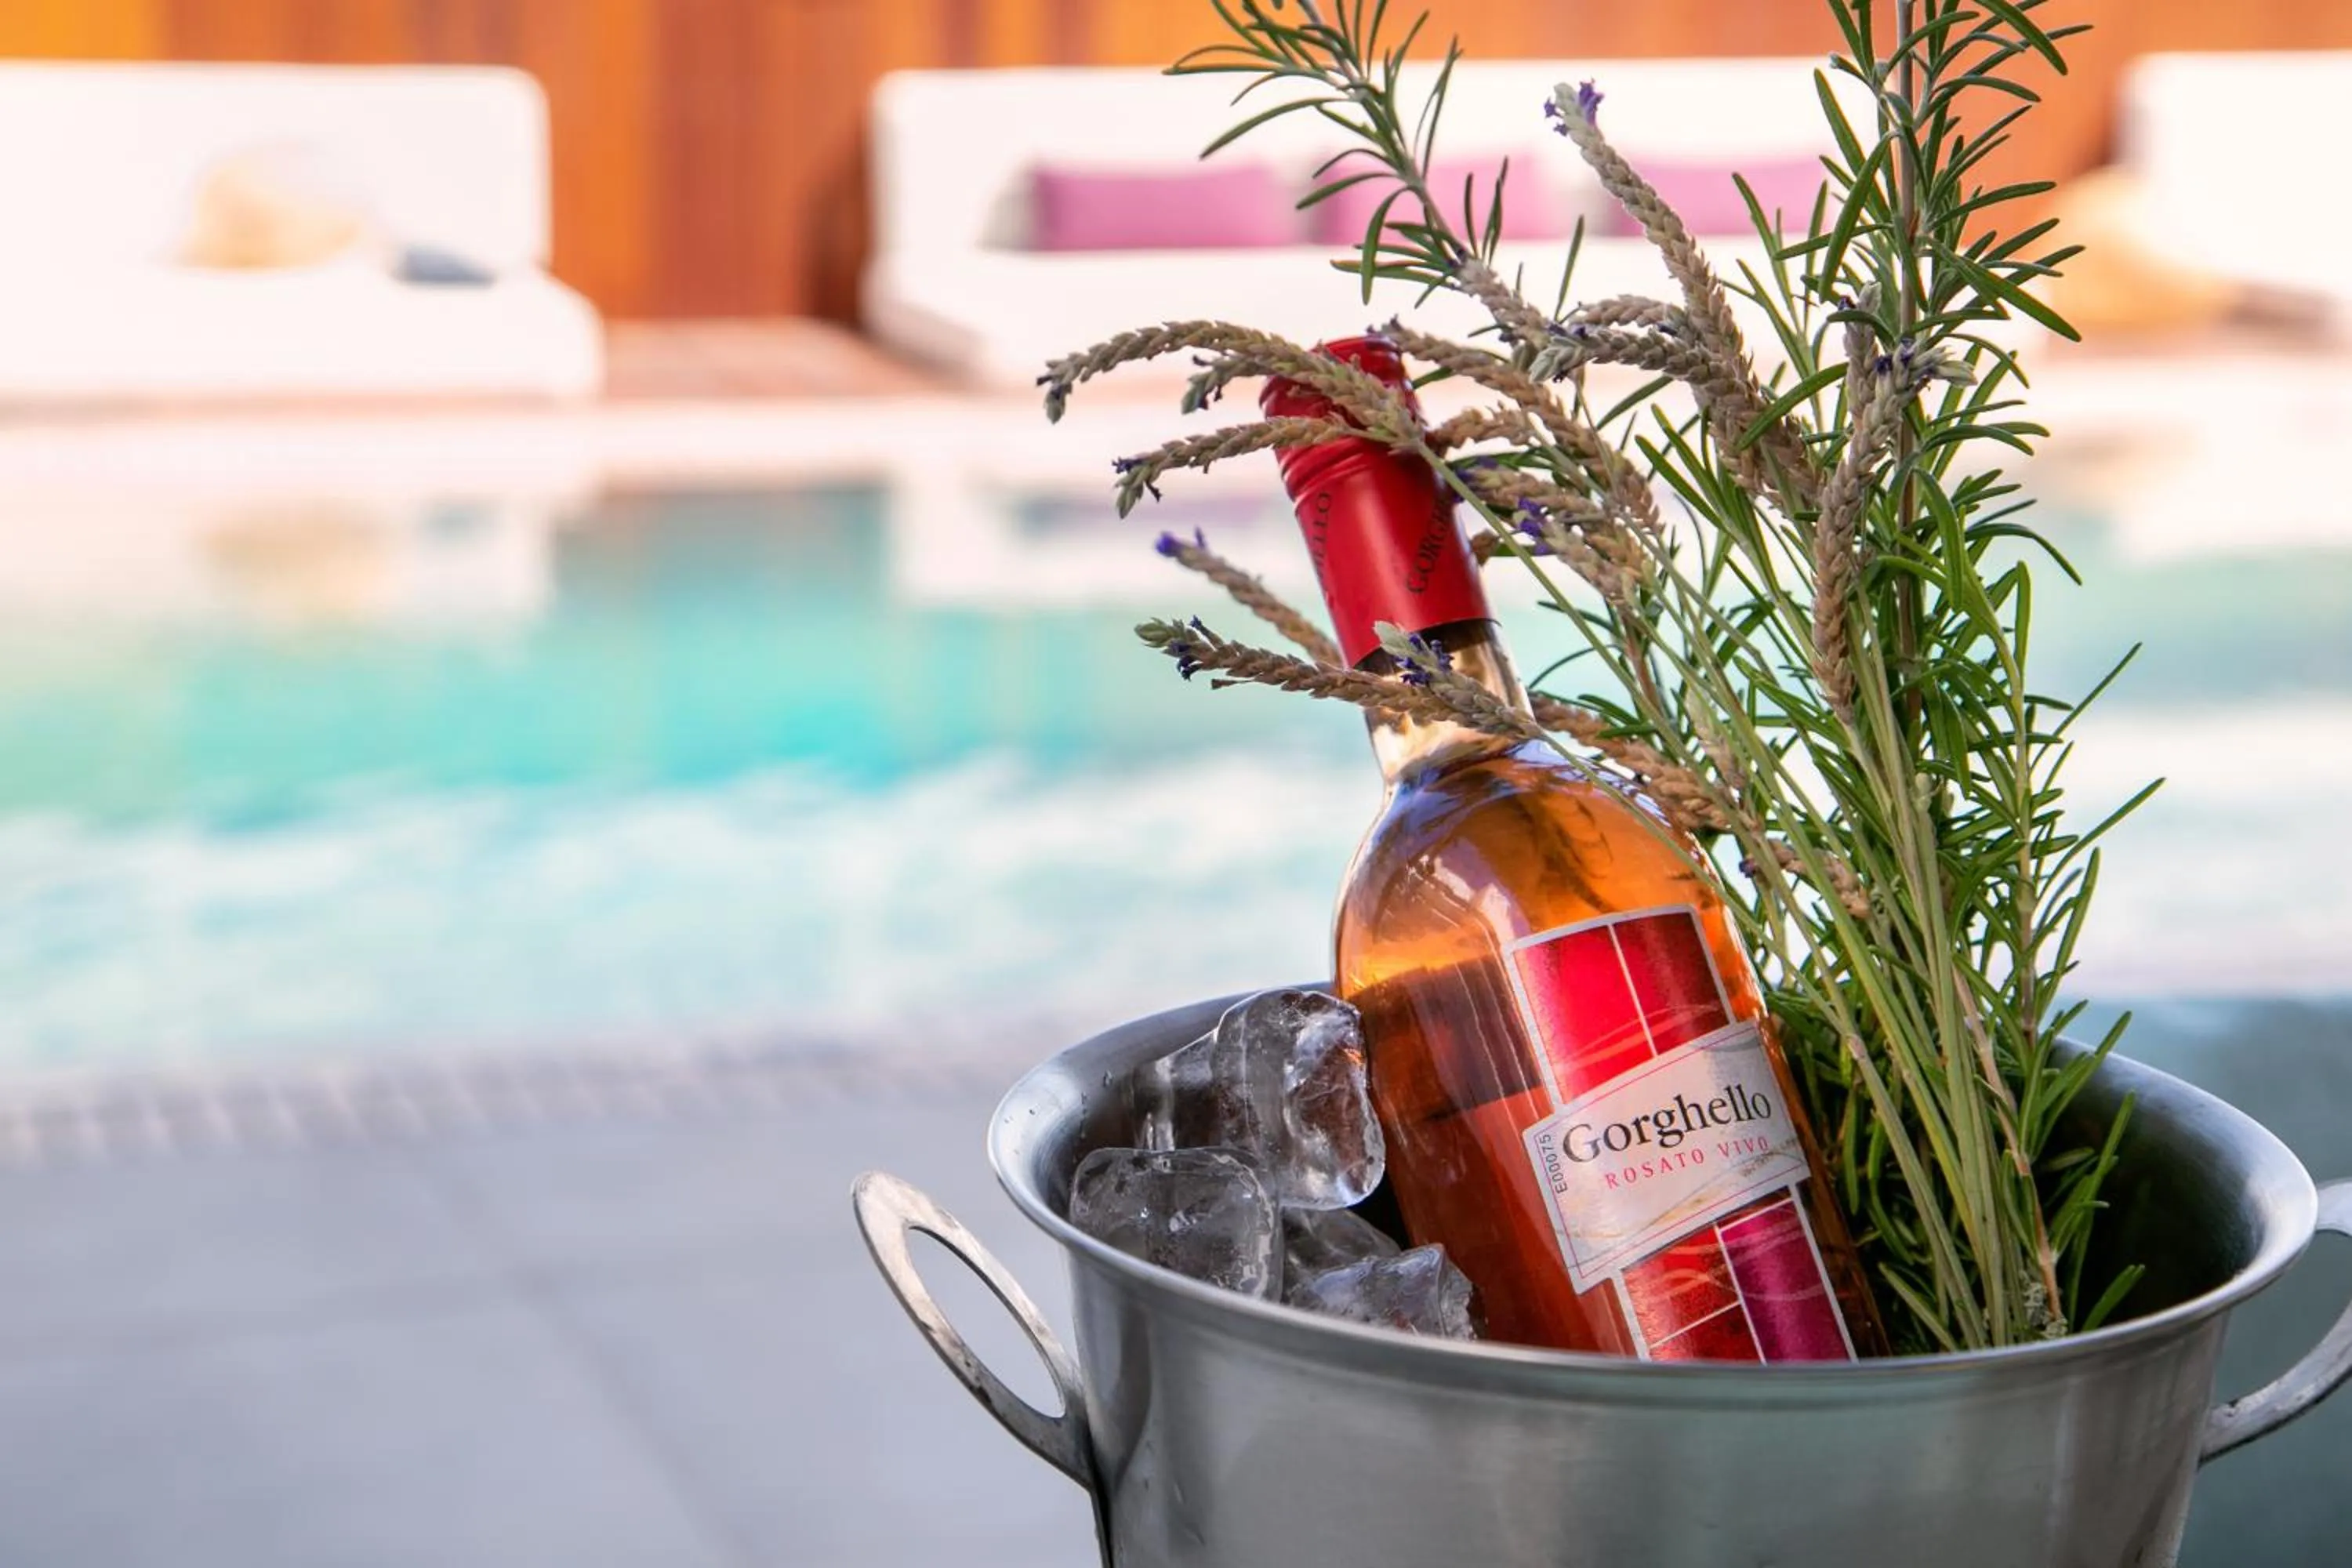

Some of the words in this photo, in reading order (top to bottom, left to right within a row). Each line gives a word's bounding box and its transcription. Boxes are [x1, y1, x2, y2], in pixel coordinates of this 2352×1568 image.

[1563, 1083, 1772, 1163] Gorghello
[1540, 1134, 1568, 1193] E00075
[1605, 1149, 1704, 1189] ROSATO
[1718, 1137, 1769, 1158] VIVO
